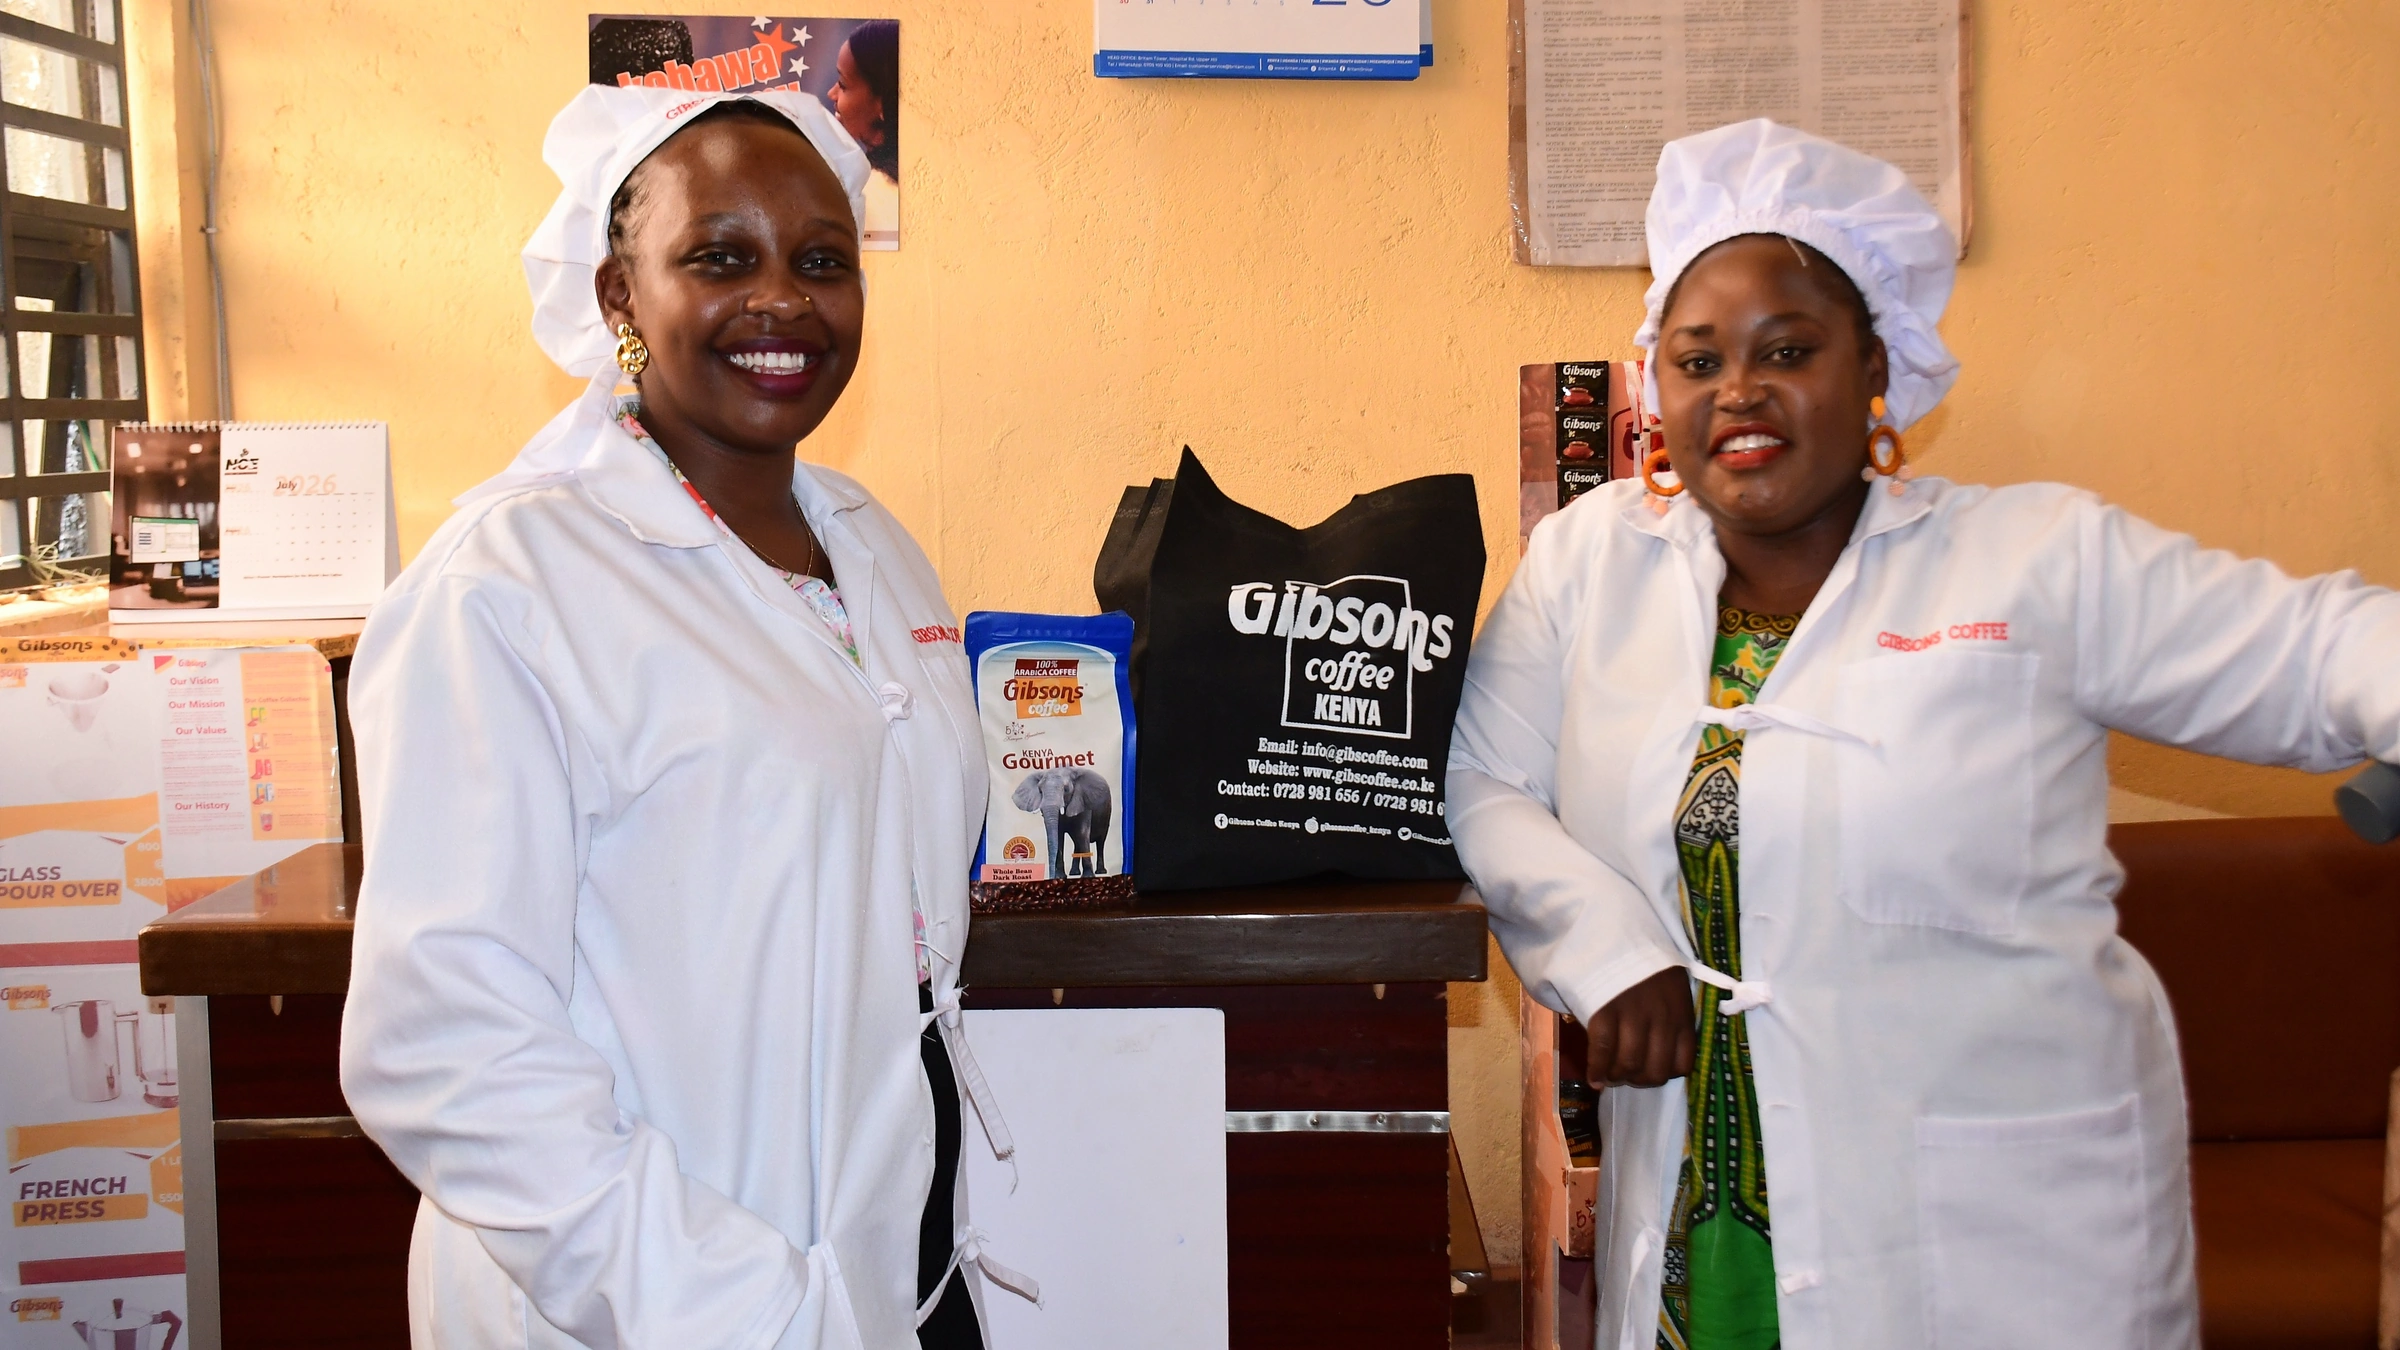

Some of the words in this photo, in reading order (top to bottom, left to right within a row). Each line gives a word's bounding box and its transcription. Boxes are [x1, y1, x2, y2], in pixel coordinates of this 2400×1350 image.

[1562, 364, 1601, 378] Gibsons
[1563, 418, 1600, 432] Gibsons
[277, 481, 297, 491] July
[1564, 471, 1601, 485] Gibsons
[1228, 579, 1454, 672] Gibsons
[1878, 631, 1941, 652] GIBSONS
[1948, 622, 2008, 640] COFFEE
[18, 640, 93, 652] Gibsons
[1305, 651, 1395, 692] coffee
[190, 676, 219, 684] Vision
[1004, 679, 1084, 703] Gibsons
[1028, 699, 1068, 716] coffee
[1314, 694, 1381, 726] KENYA
[1003, 750, 1094, 769] Gourmet
[1022, 749, 1053, 757] KENYA
[1257, 737, 1298, 755] Email:
[1302, 741, 1428, 770] info@gibscoffee.com
[1248, 759, 1299, 777] Website:
[1217, 779, 1269, 797] Contact:
[1273, 783, 1305, 799] 0728
[1308, 785, 1331, 801] 981
[1335, 787, 1360, 803] 656
[1374, 793, 1406, 811] 0728
[1410, 798, 1433, 816] 981
[196, 802, 230, 810] History
[1229, 818, 1254, 826] Gibsons
[1256, 819, 1277, 827] Coffee
[1278, 820, 1300, 830] Kenya
[0, 866, 61, 882] GLASS
[62, 883, 119, 898] OVER
[0, 987, 52, 1001] Gibsons
[20, 1176, 127, 1200] FRENCH
[22, 1200, 105, 1222] PRESS
[11, 1299, 63, 1312] Gibsons
